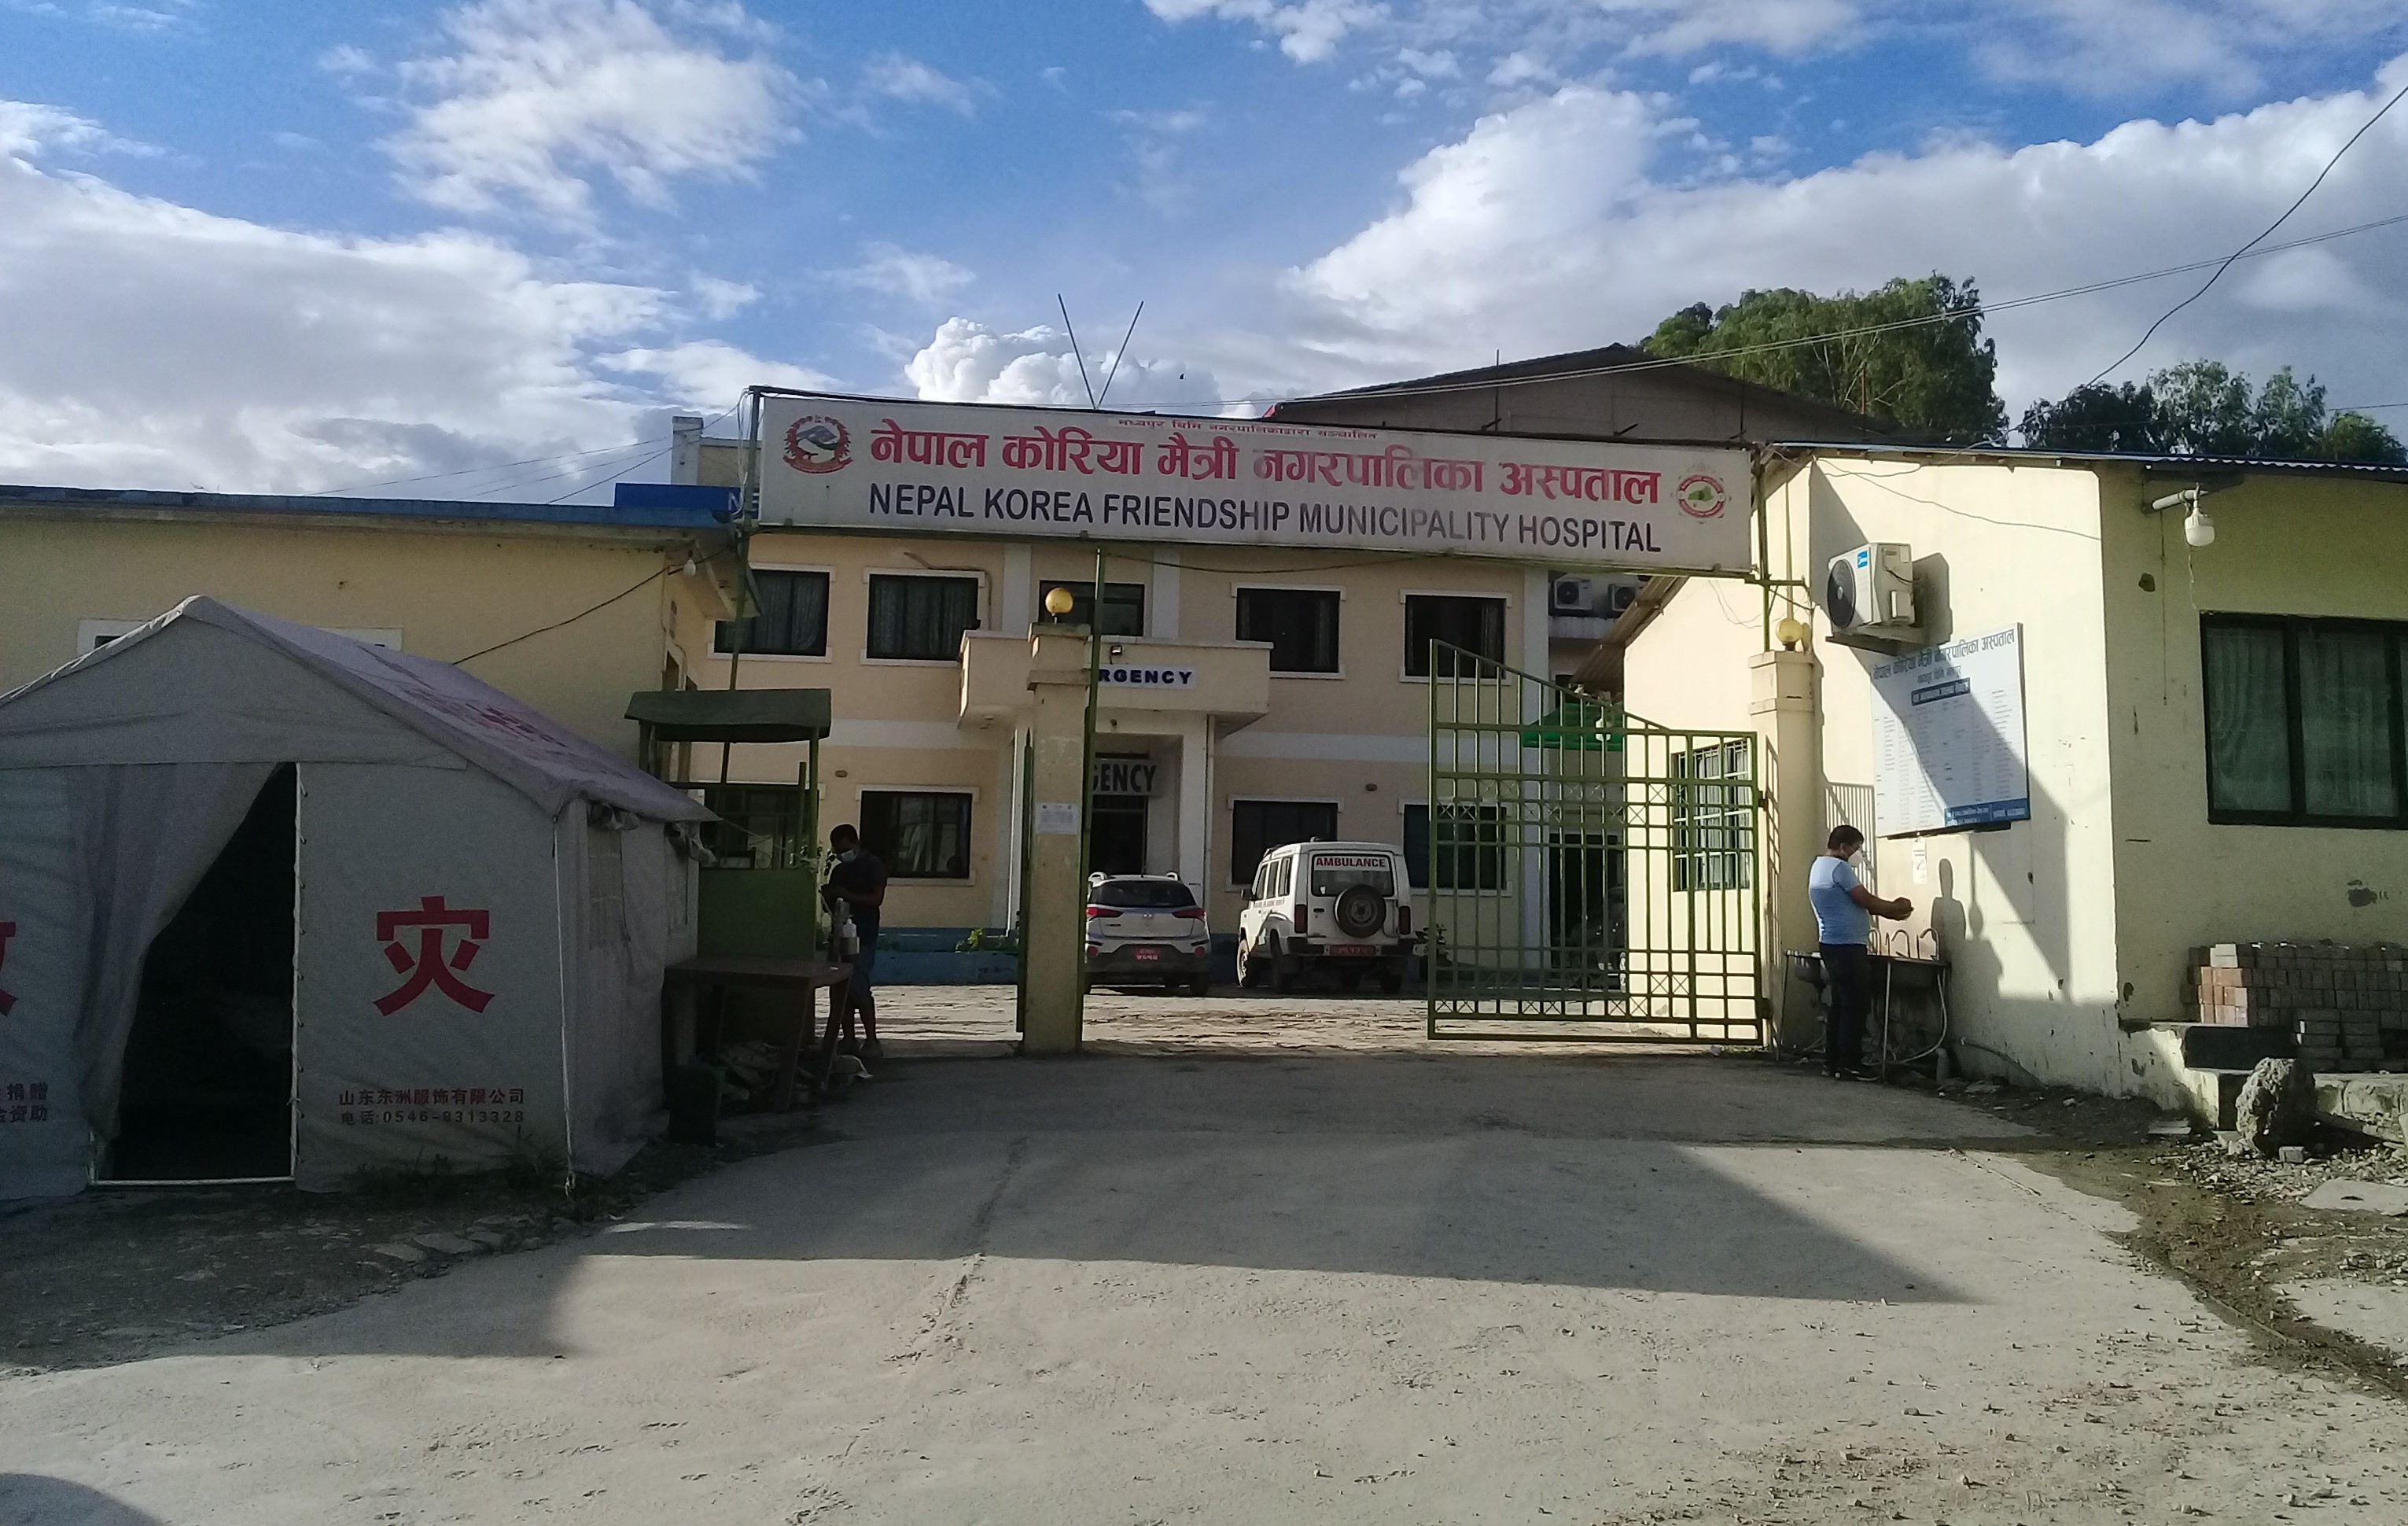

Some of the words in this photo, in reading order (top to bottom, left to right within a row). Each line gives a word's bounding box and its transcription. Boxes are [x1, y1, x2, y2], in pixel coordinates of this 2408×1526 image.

[871, 418, 989, 468] नेपाल
[1003, 426, 1145, 475] कोरिया
[1158, 432, 1240, 481] मैत्री
[1254, 444, 1485, 492] नगरपालिका
[1499, 462, 1662, 504] अस्पताल
[870, 483, 974, 518] NEPAL
[985, 488, 1094, 524] KOREA
[1103, 494, 1290, 533] FRIENDSHIP
[1299, 502, 1510, 544] MUNICIPALITY
[1519, 514, 1662, 553] HOSPITAL
[1099, 669, 1192, 684] RGENCY
[1316, 857, 1386, 868] AMBULANCE
[372, 896, 495, 1017] 灾
